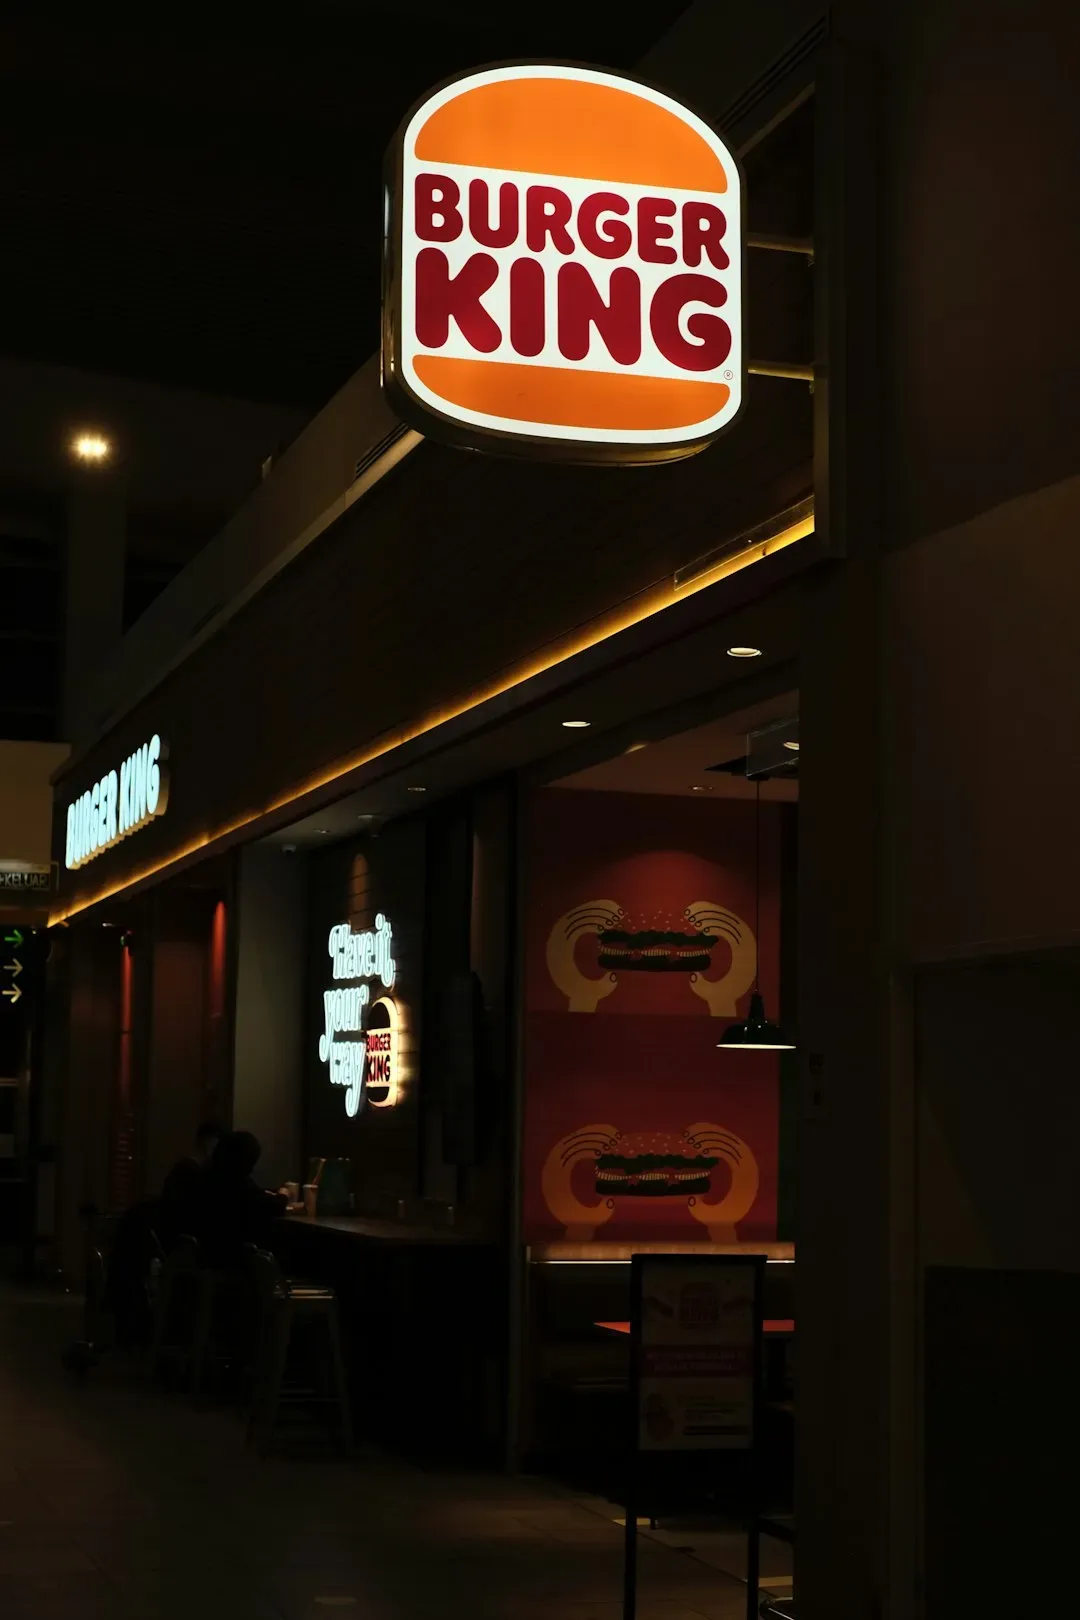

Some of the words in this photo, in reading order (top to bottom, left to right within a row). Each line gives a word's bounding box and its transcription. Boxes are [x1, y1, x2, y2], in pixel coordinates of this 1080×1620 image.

[415, 173, 730, 270] BURGER
[415, 247, 732, 372] KING
[65, 769, 118, 869] BURGER
[119, 734, 161, 835] KING
[328, 924, 376, 979] Have
[319, 984, 369, 1062] your
[366, 1033, 391, 1052] BURGER
[329, 1041, 366, 1118] way
[366, 1054, 391, 1082] KING
